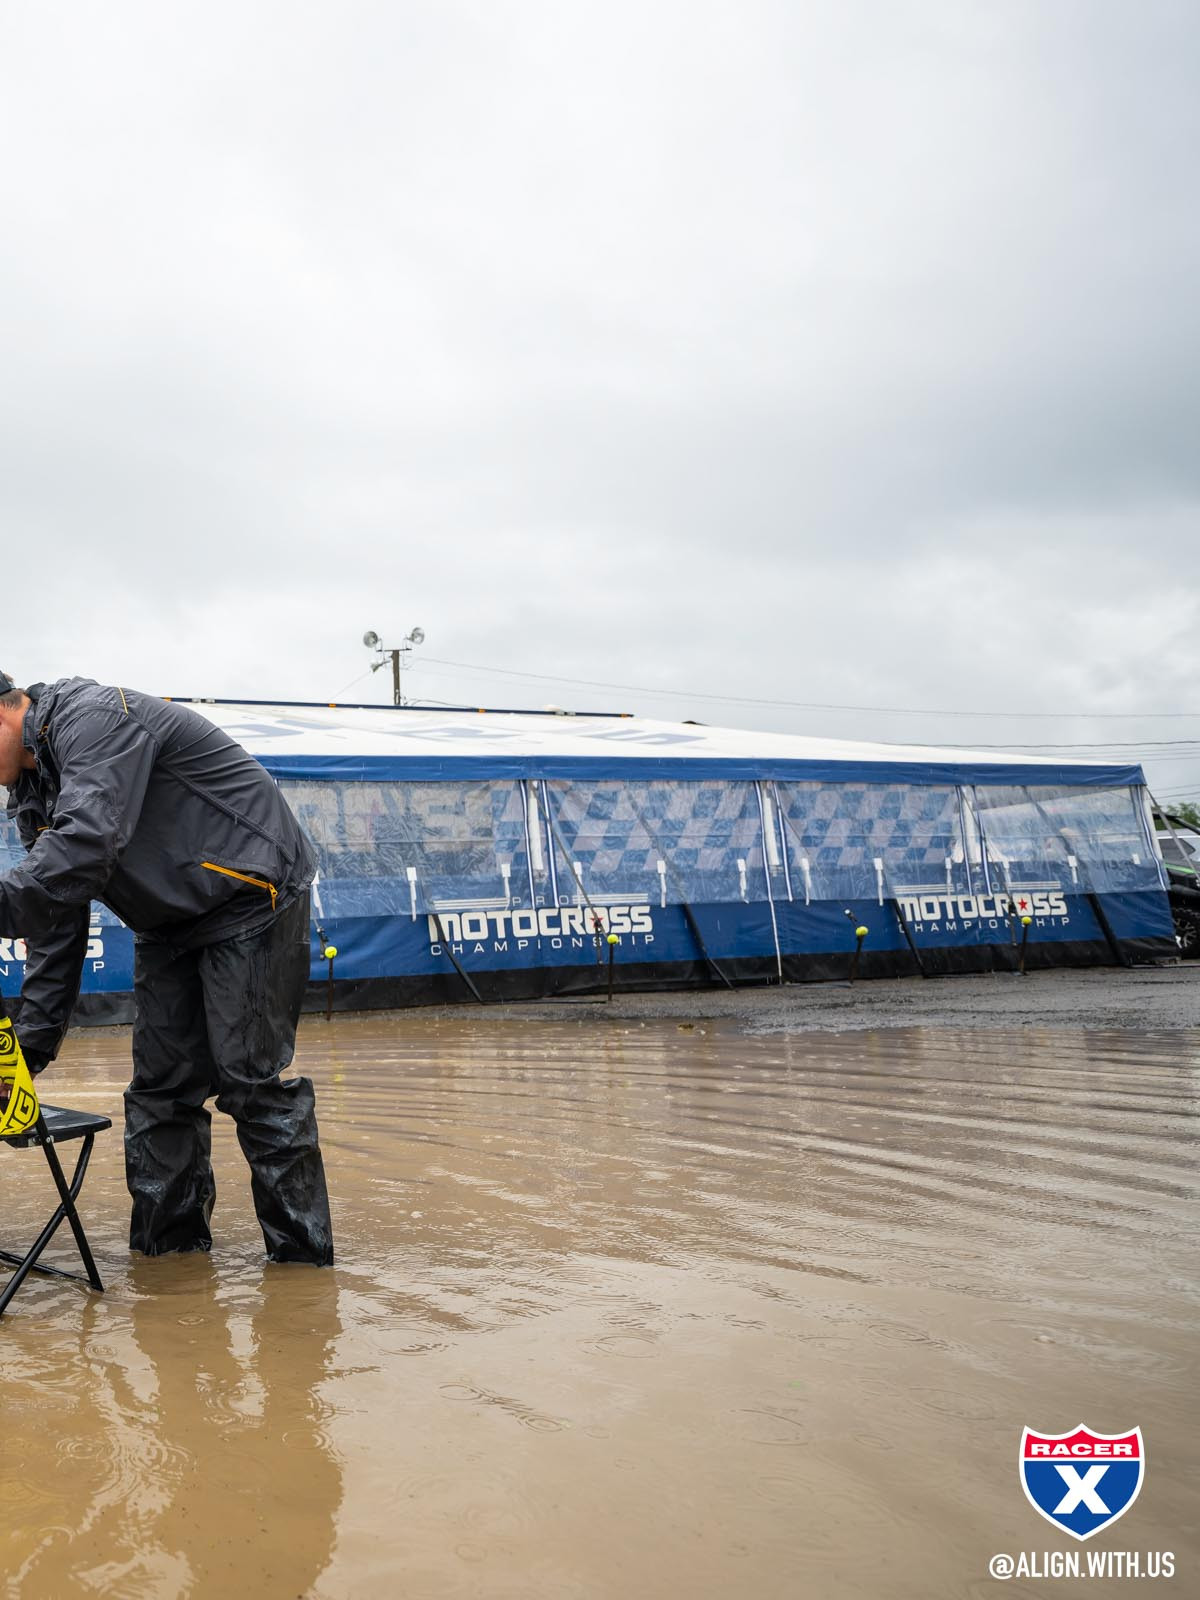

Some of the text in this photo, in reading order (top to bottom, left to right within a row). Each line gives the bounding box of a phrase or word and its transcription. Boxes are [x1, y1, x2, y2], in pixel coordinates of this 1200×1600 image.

[956, 882, 1000, 893] PRO
[512, 895, 569, 907] PRO
[428, 905, 653, 943] MOTOCROSS
